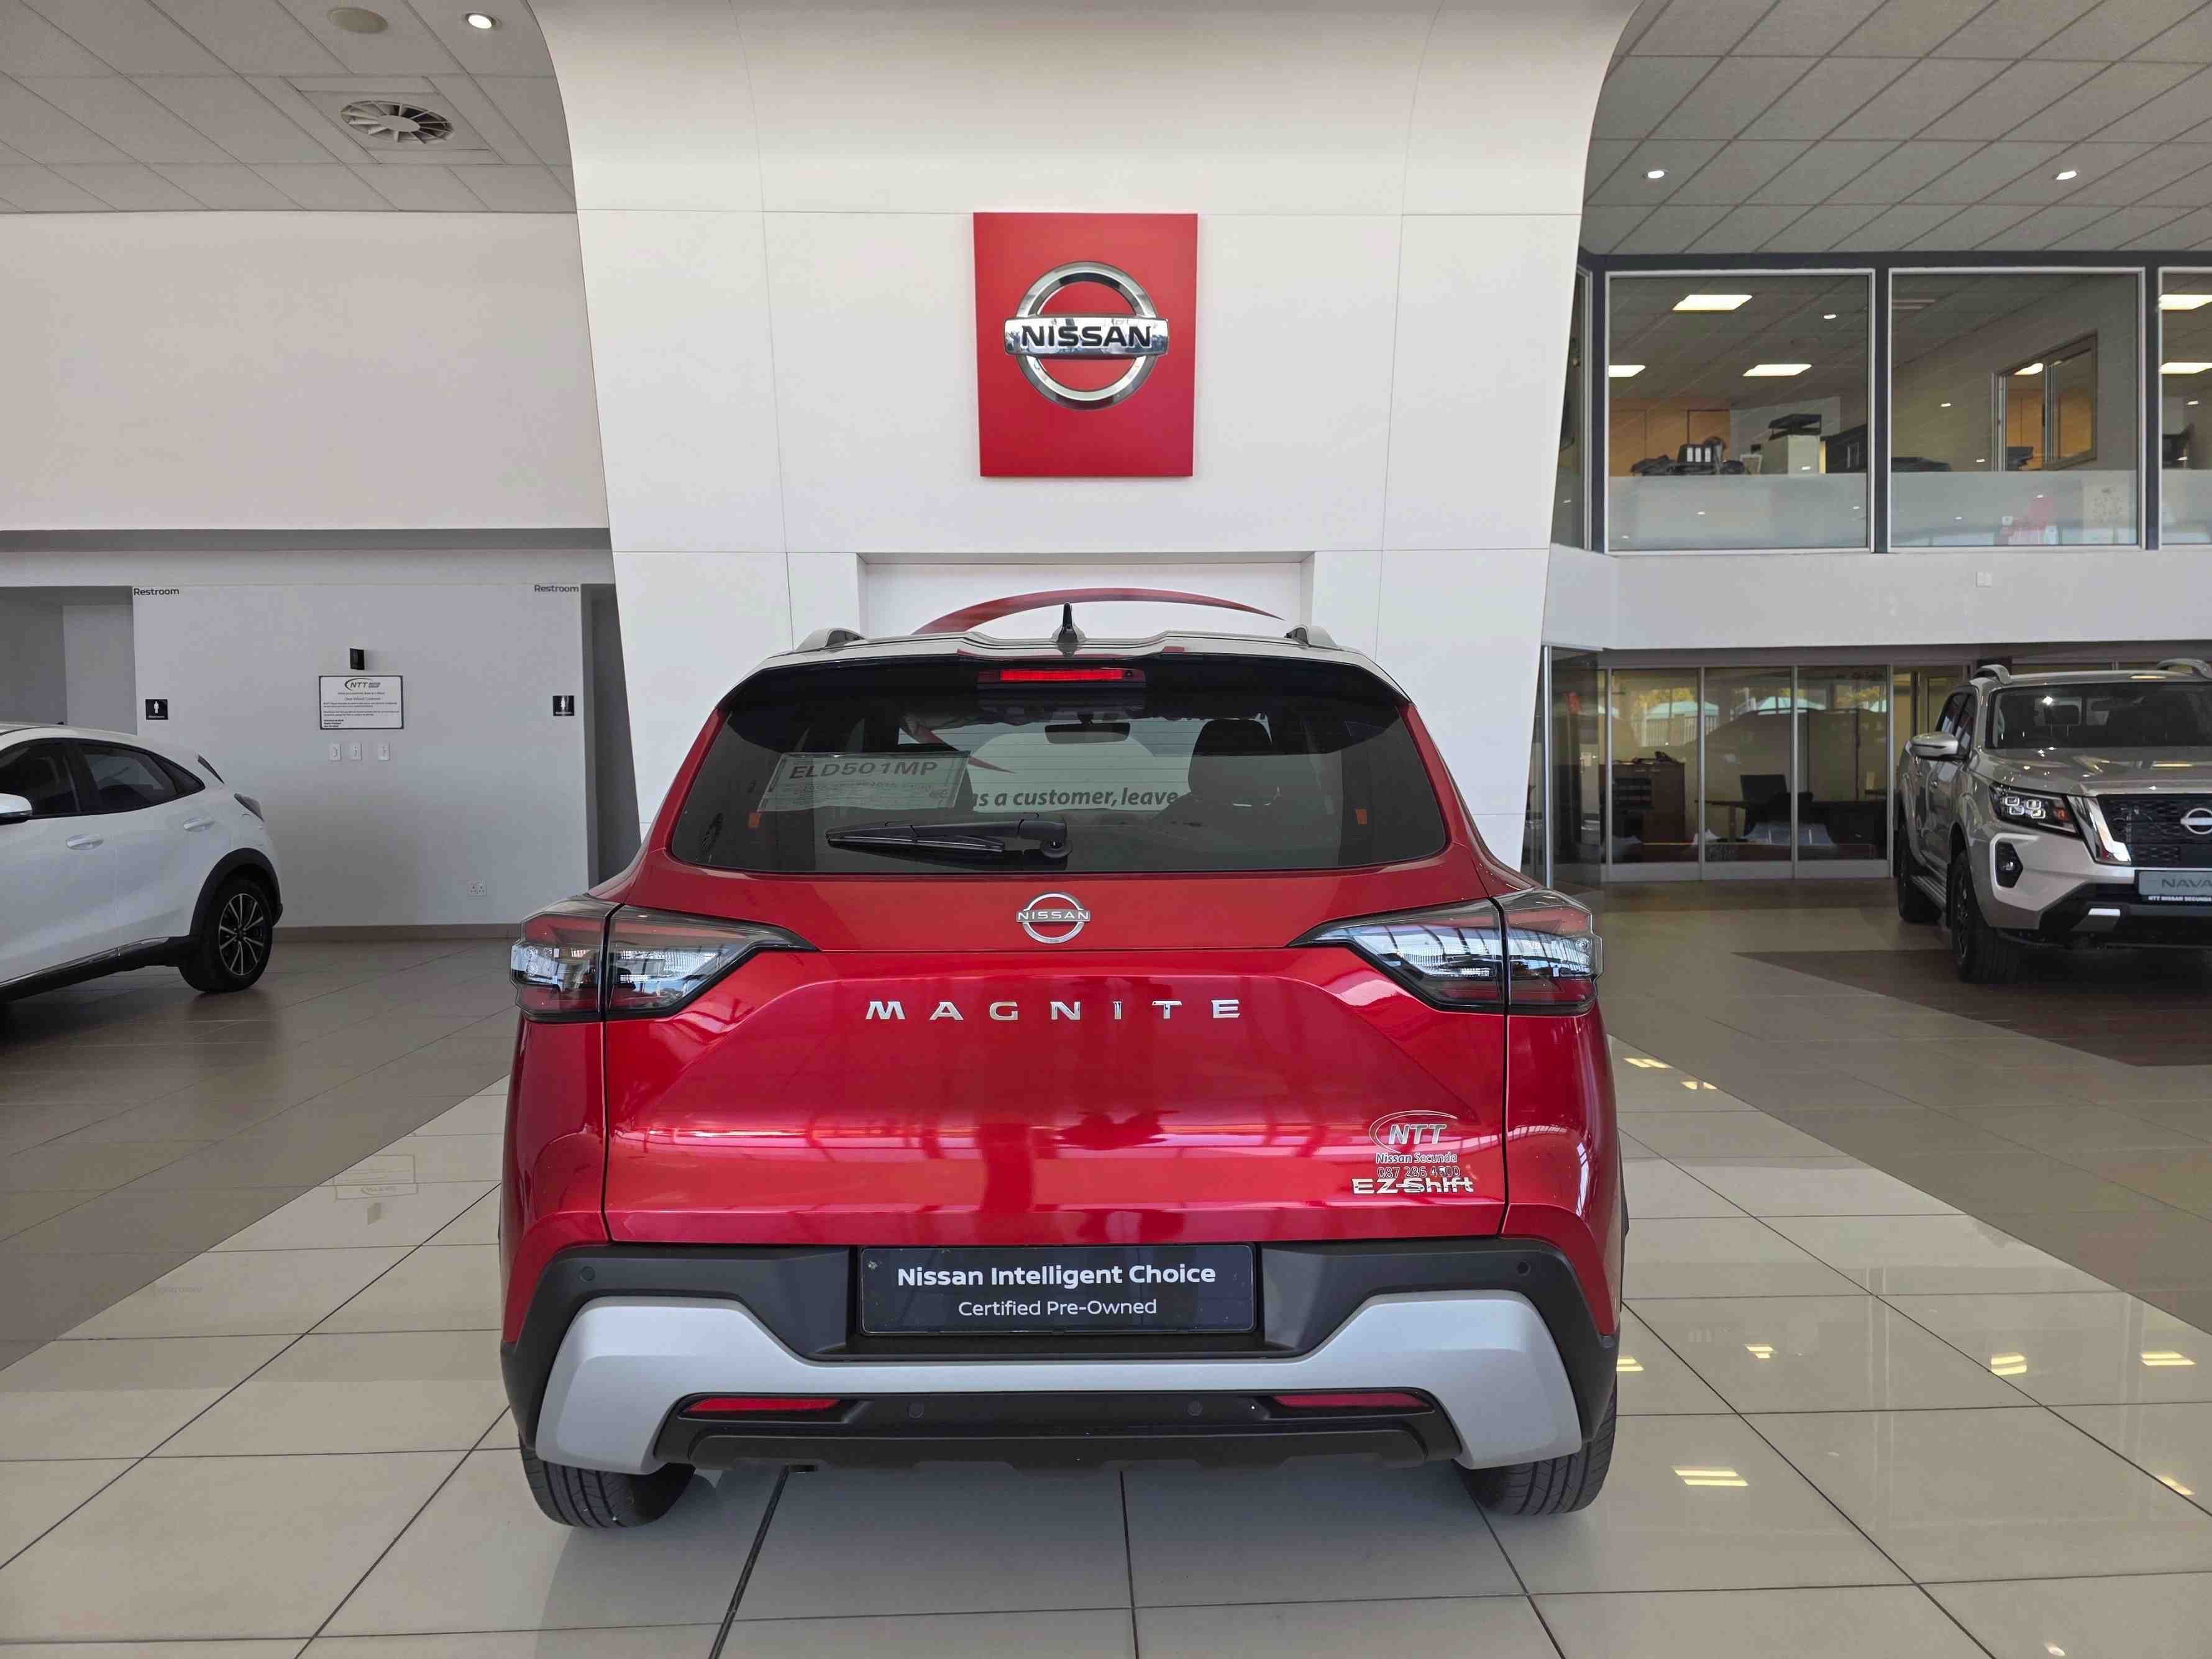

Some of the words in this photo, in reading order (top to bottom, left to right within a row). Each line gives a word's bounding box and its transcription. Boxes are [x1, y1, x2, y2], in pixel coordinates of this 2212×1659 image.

[1021, 324, 1151, 347] NISSAN
[133, 588, 180, 596] Restroom
[534, 584, 579, 592] Restroom
[789, 761, 939, 779] ELD501MP
[994, 793, 1008, 807] a
[1013, 789, 1118, 807] customer,
[1120, 787, 1179, 807] leave
[1018, 911, 1089, 920] NISSAN
[865, 999, 1241, 1021] MAGNITE
[1387, 1123, 1447, 1145] NTT
[1375, 1152, 1412, 1164] Nissan
[1413, 1151, 1458, 1164] Secunda
[1377, 1166, 1401, 1179] 087
[1404, 1166, 1427, 1178] 286
[1351, 1177, 1474, 1194] EZ-Shift
[898, 1266, 984, 1286] Nissan
[991, 1265, 1123, 1289] Intelligent
[1128, 1263, 1217, 1284] Choice
[957, 1300, 1041, 1317] Certified
[1046, 1299, 1158, 1315] Pre-Owned
